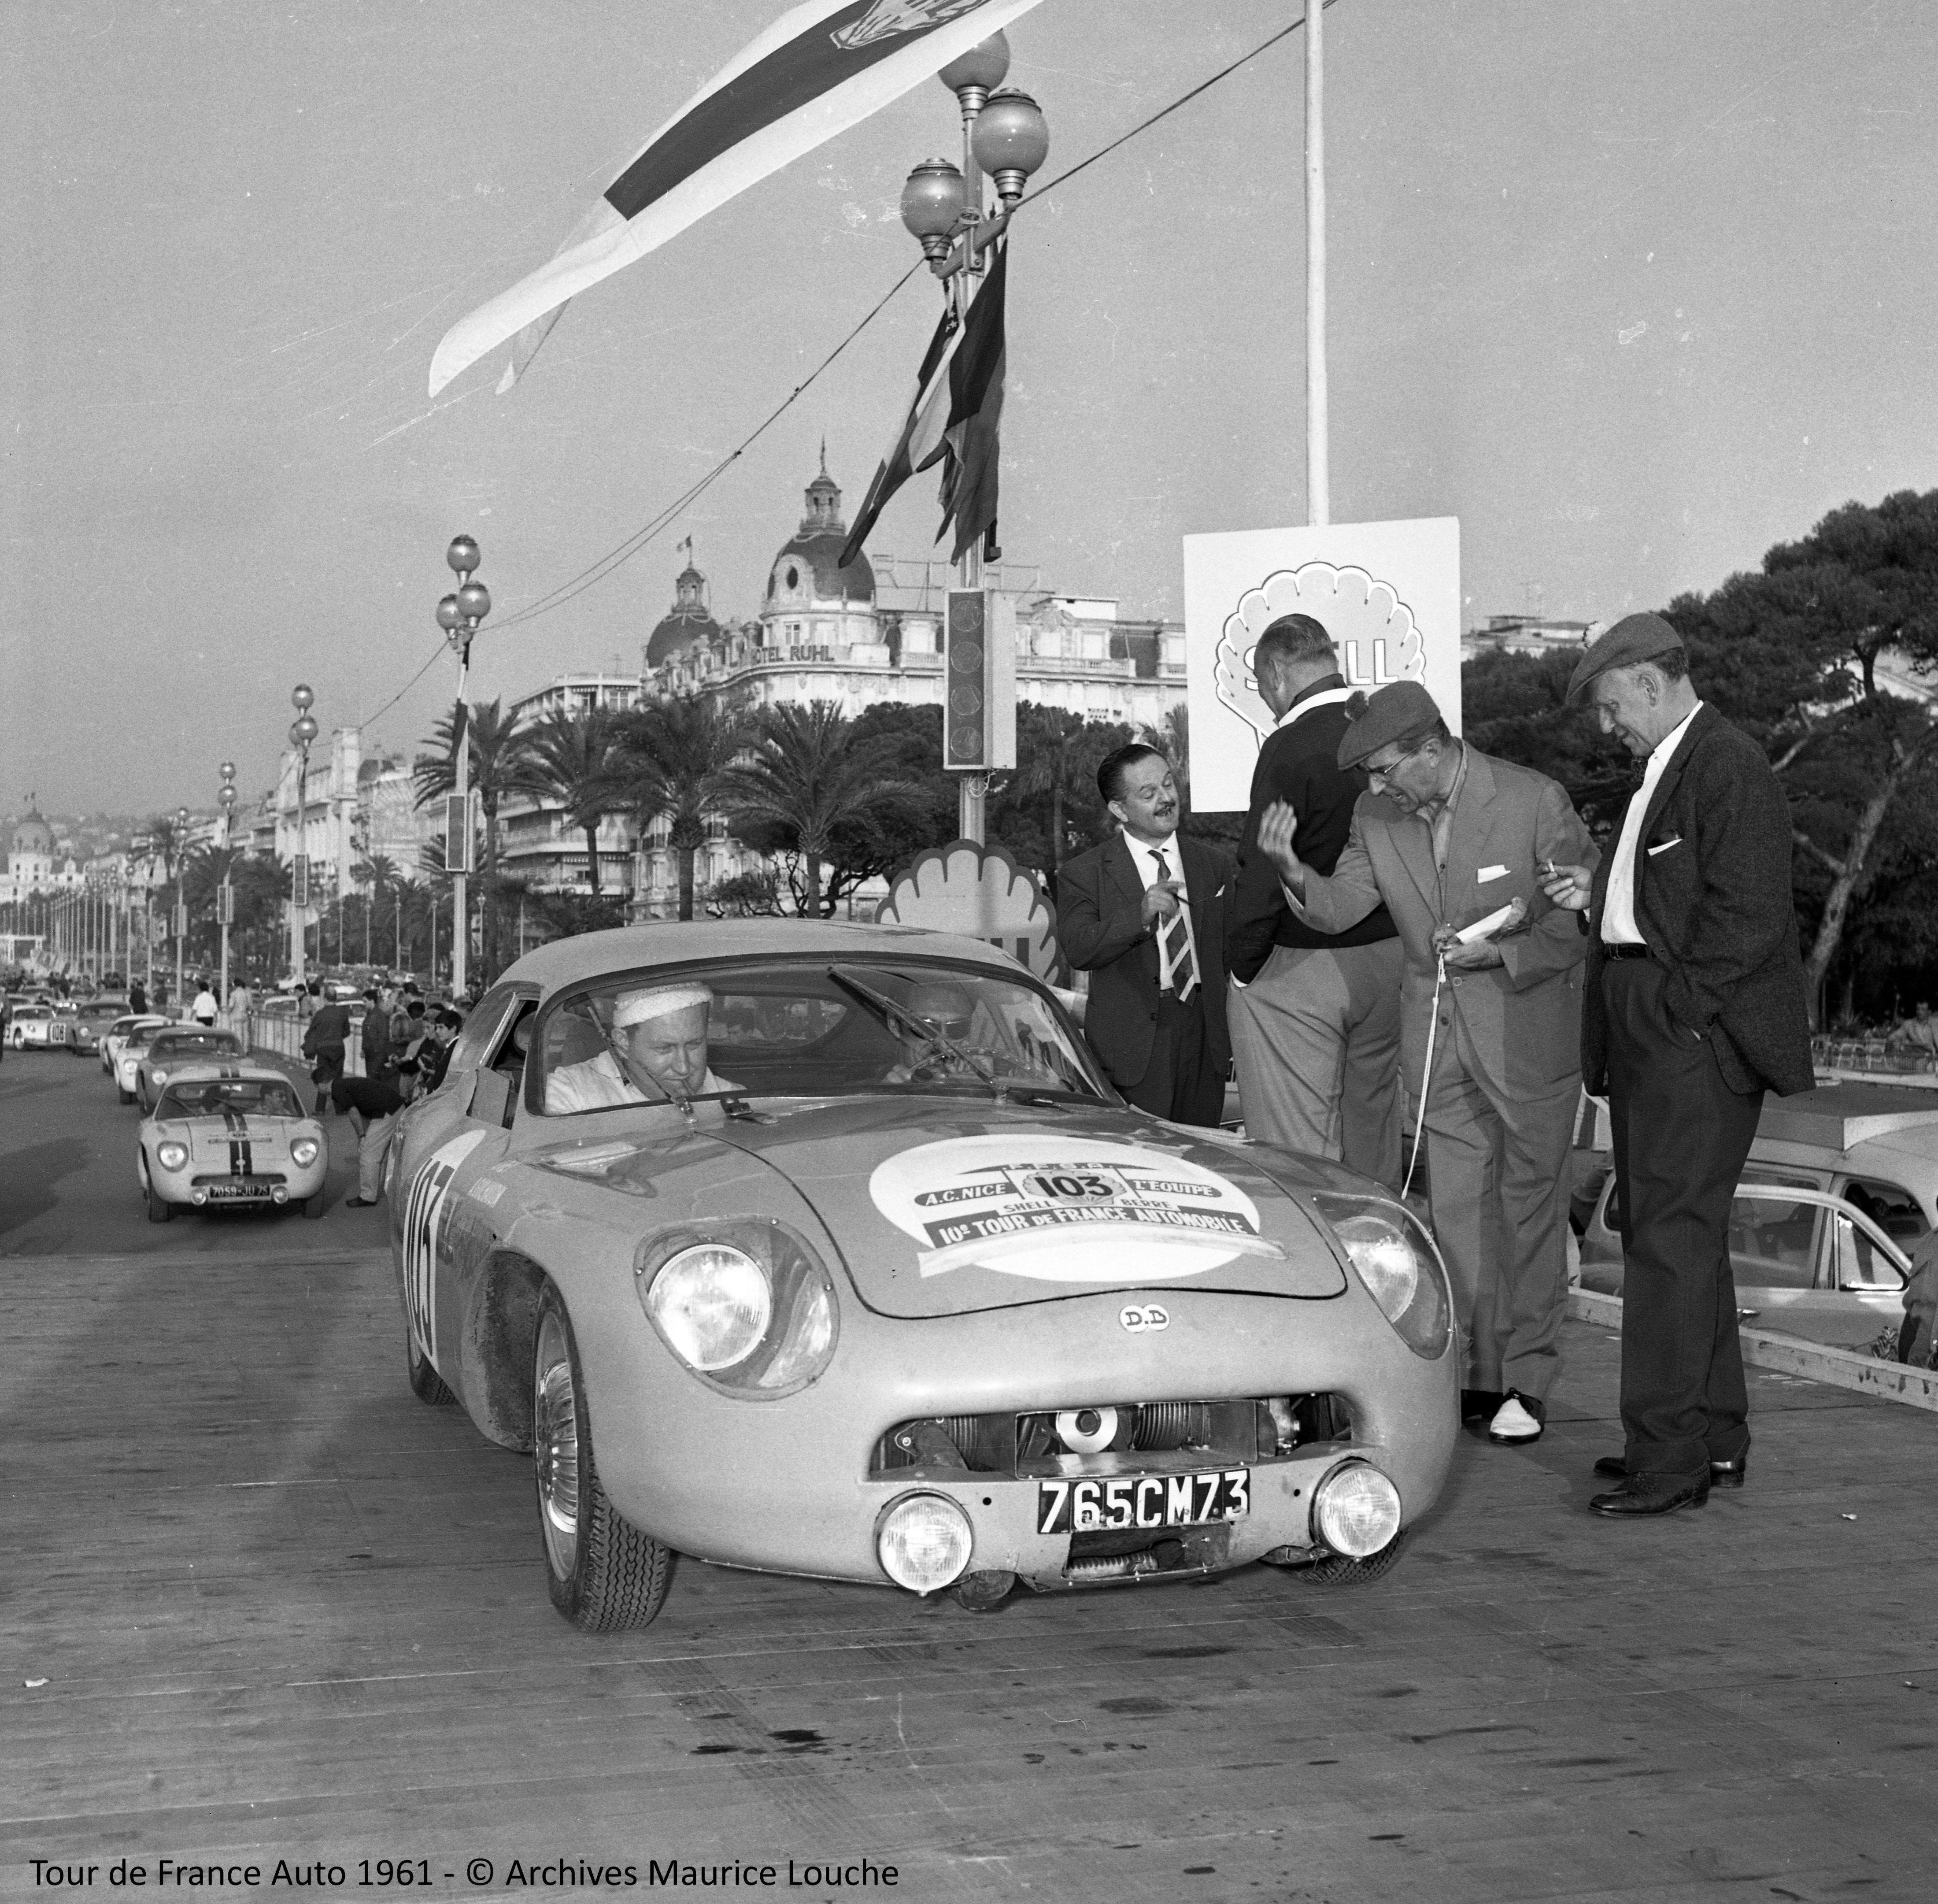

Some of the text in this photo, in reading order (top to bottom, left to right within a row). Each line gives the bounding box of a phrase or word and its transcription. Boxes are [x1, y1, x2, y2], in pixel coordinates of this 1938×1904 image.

[791, 645, 834, 661] RUHL
[1035, 1176, 1113, 1196] 103
[1004, 1199, 1171, 1212] SHELL BERRE
[972, 1215, 1030, 1236] TOUR
[1031, 1214, 1055, 1226] DE
[1053, 1207, 1131, 1223] FRANCE
[1134, 1208, 1247, 1234] AUTOMOBILE
